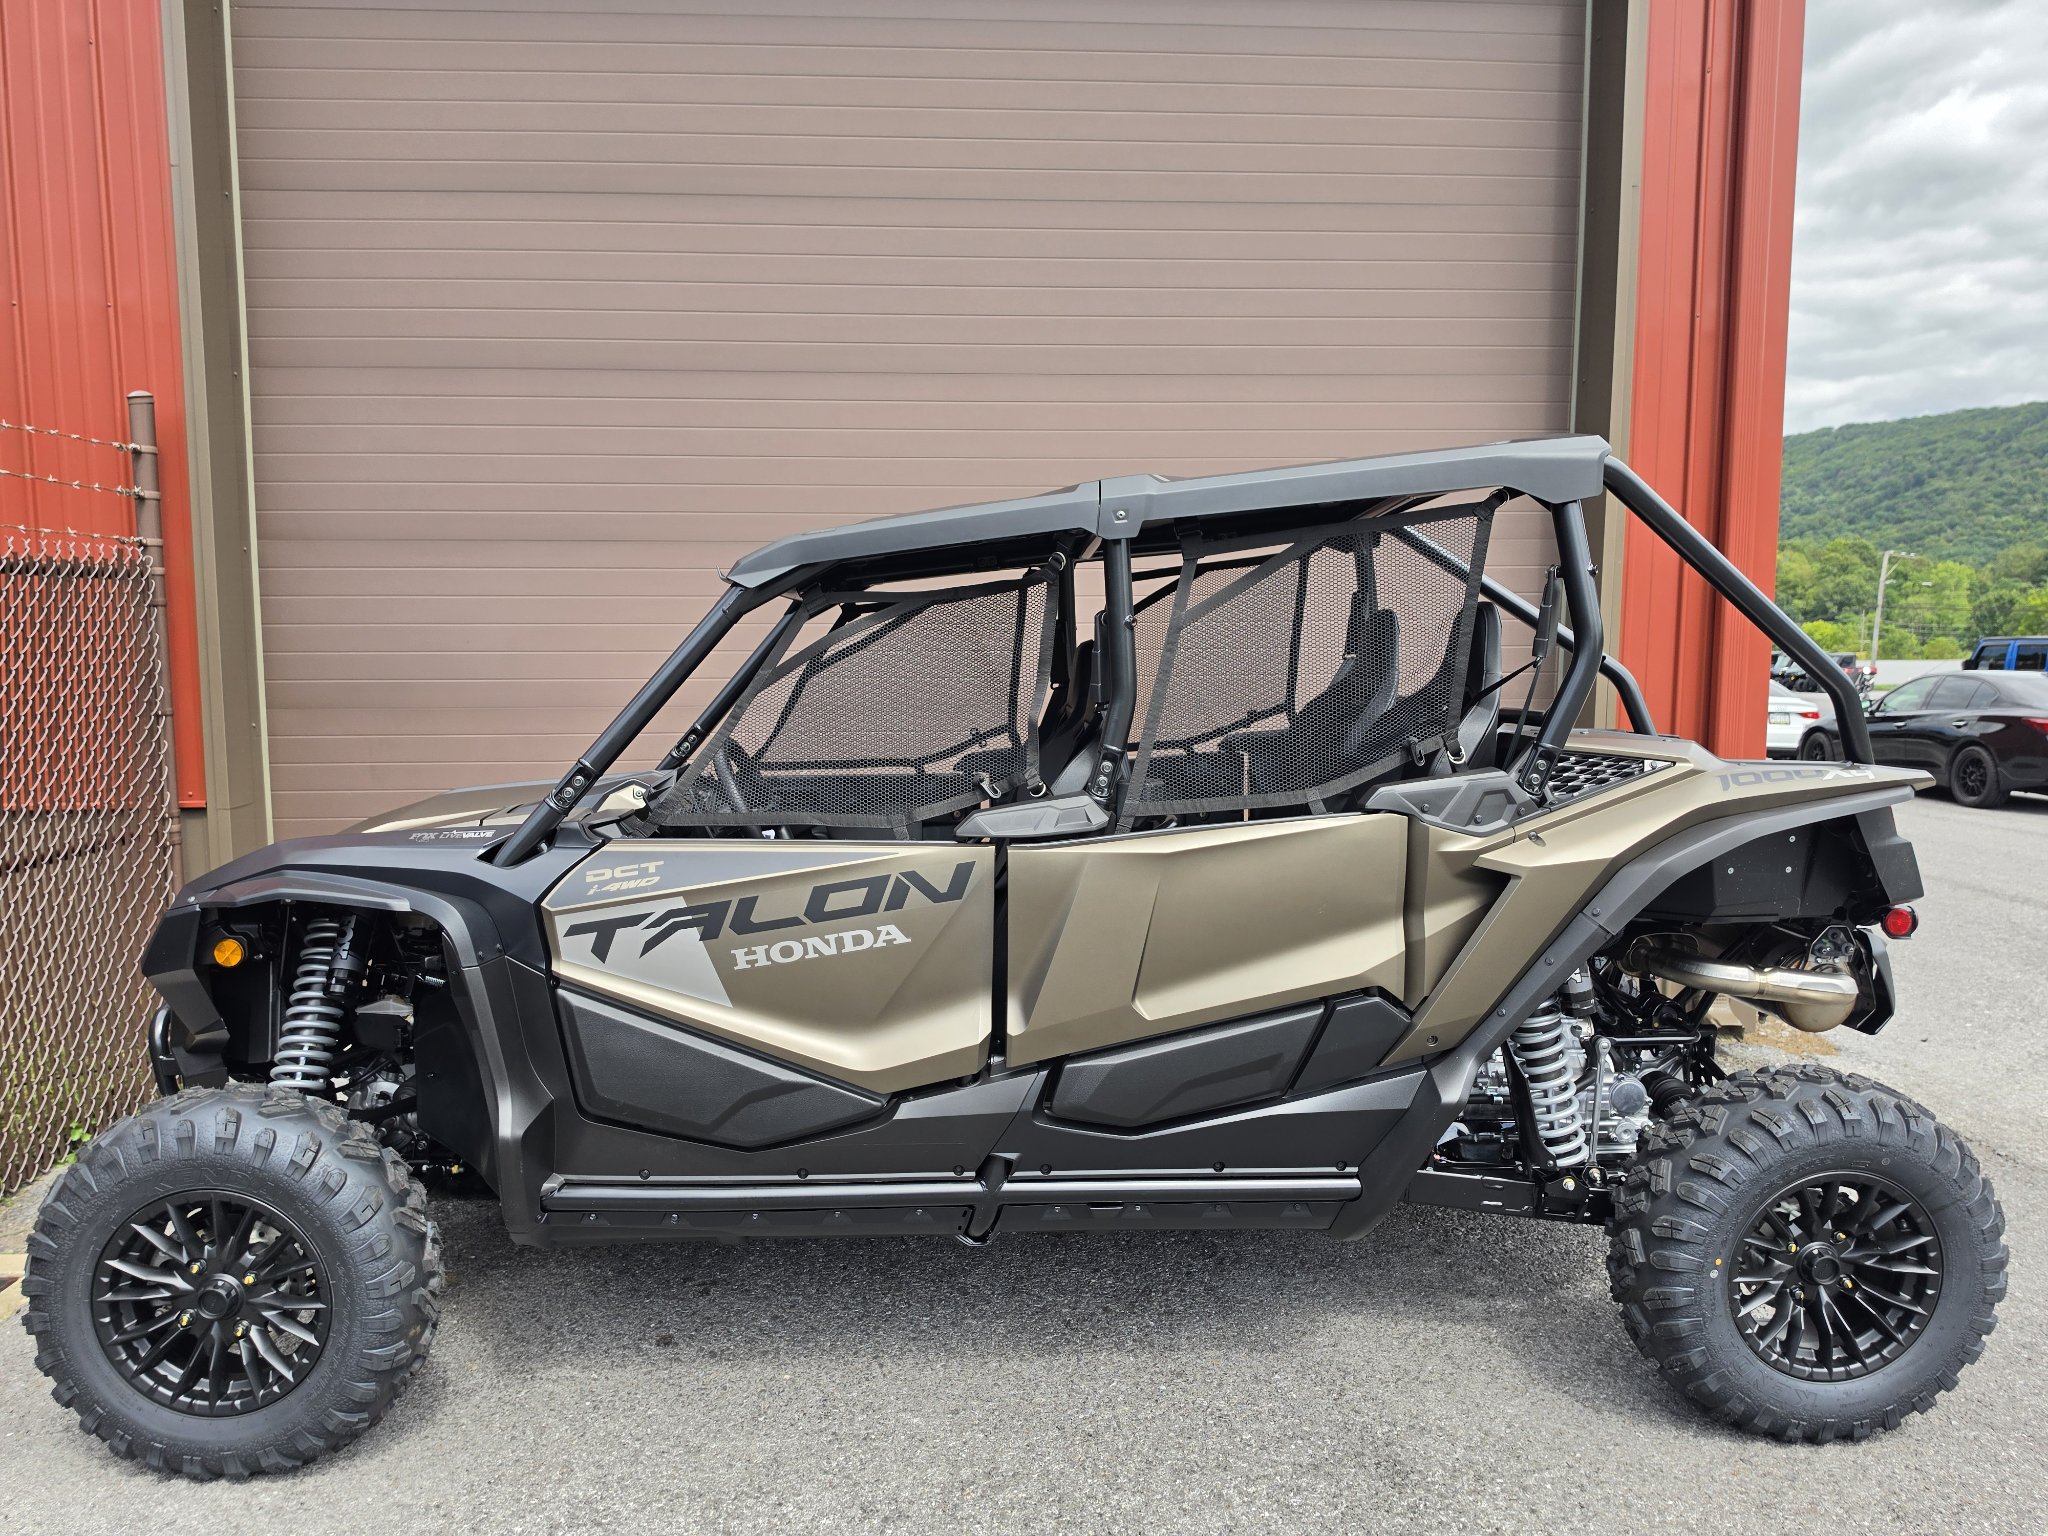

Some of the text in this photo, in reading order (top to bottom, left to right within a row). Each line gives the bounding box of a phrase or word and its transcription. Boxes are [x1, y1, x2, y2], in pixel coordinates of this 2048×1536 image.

[585, 860, 665, 883] DCT
[562, 860, 977, 965] TALON
[730, 923, 912, 971] HONDA
[143, 1166, 276, 1203] KENDA
